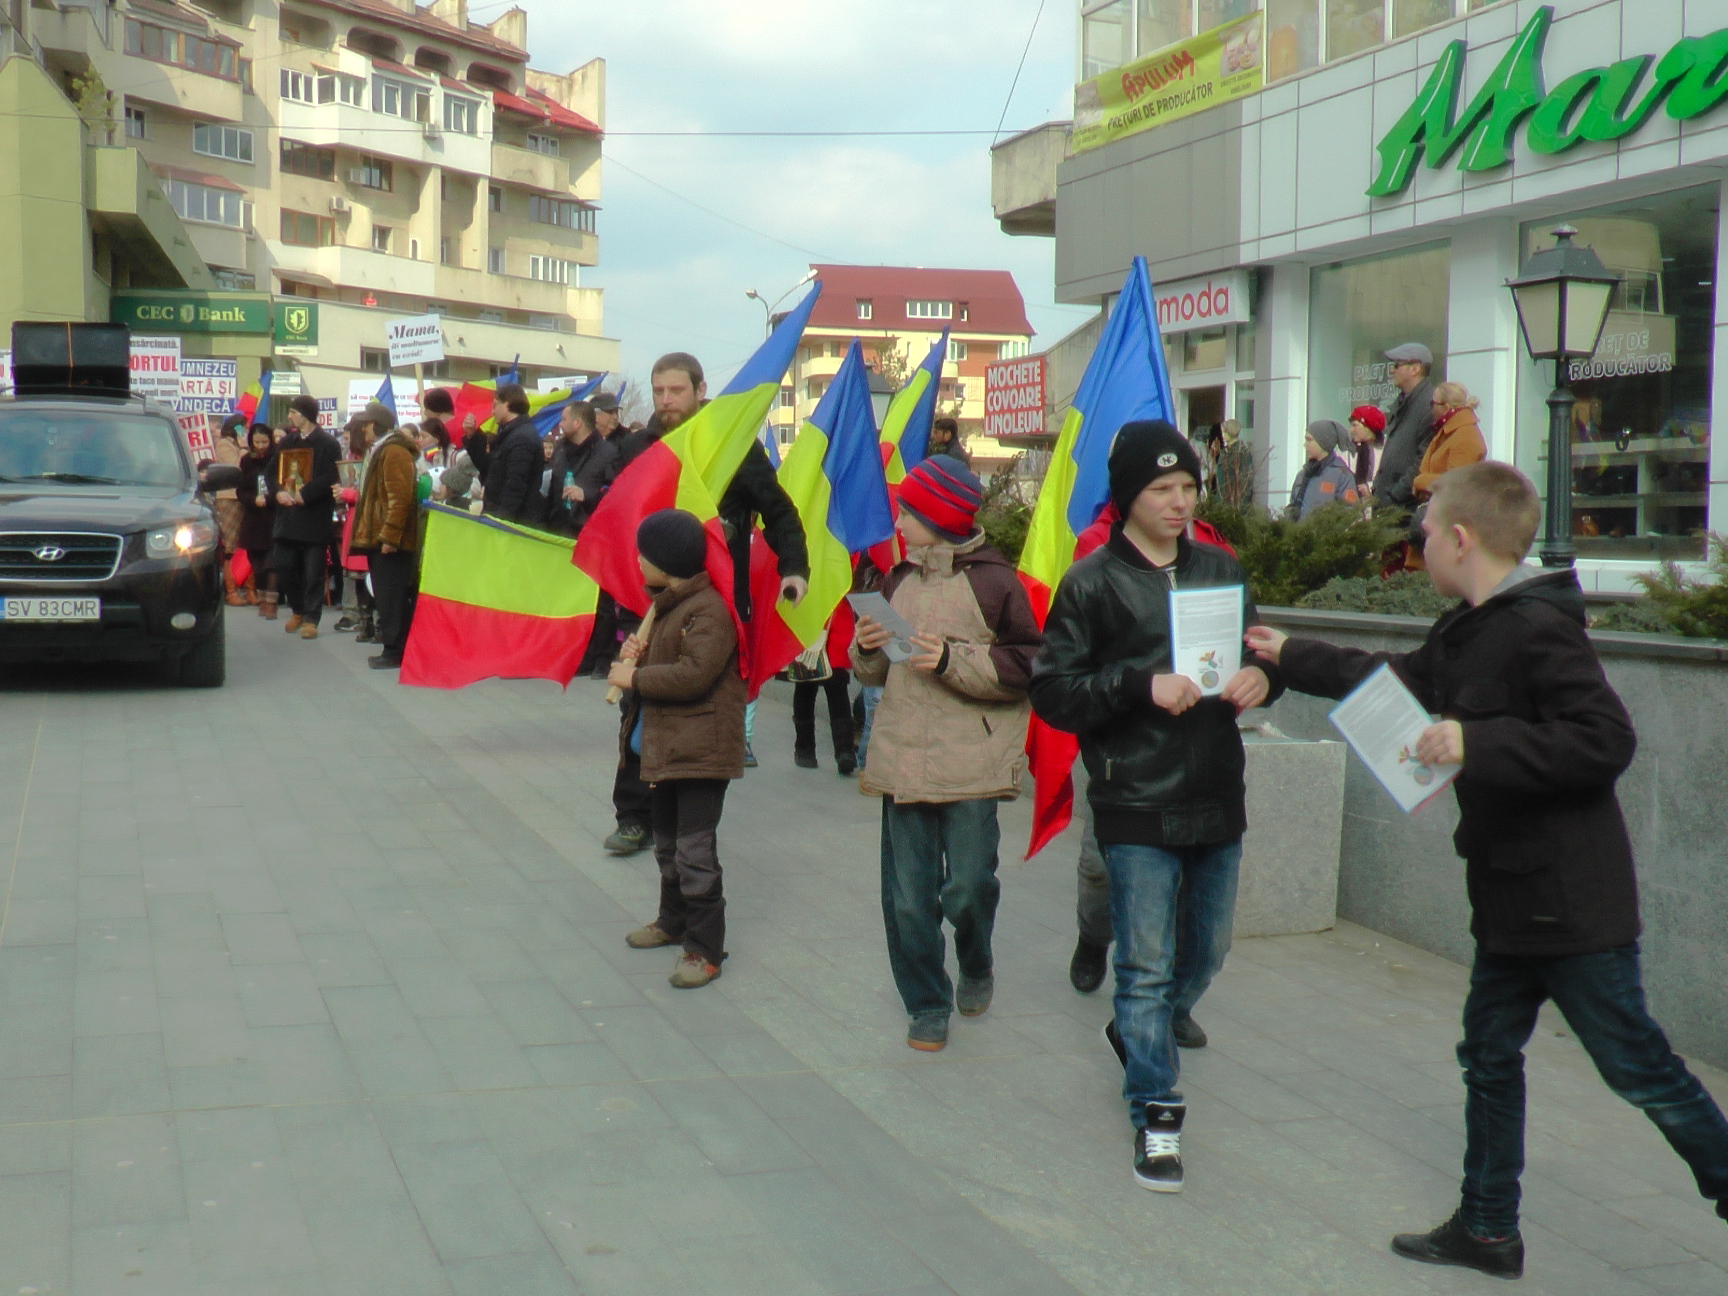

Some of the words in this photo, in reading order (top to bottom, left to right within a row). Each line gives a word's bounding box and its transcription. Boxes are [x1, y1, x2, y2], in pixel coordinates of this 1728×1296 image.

[1121, 50, 1195, 103] APULUM
[1143, 104, 1156, 119] DE
[136, 305, 175, 320] CEC
[198, 306, 246, 322] Bank
[1626, 330, 1649, 350] DE
[988, 361, 1041, 389] MOCHETE
[1568, 353, 1672, 381] RODUCĂTOR
[987, 385, 1041, 412] COVOARE
[985, 410, 1043, 435] LINOLEUM
[7, 600, 32, 617] SV
[39, 600, 96, 617] 83CMR
